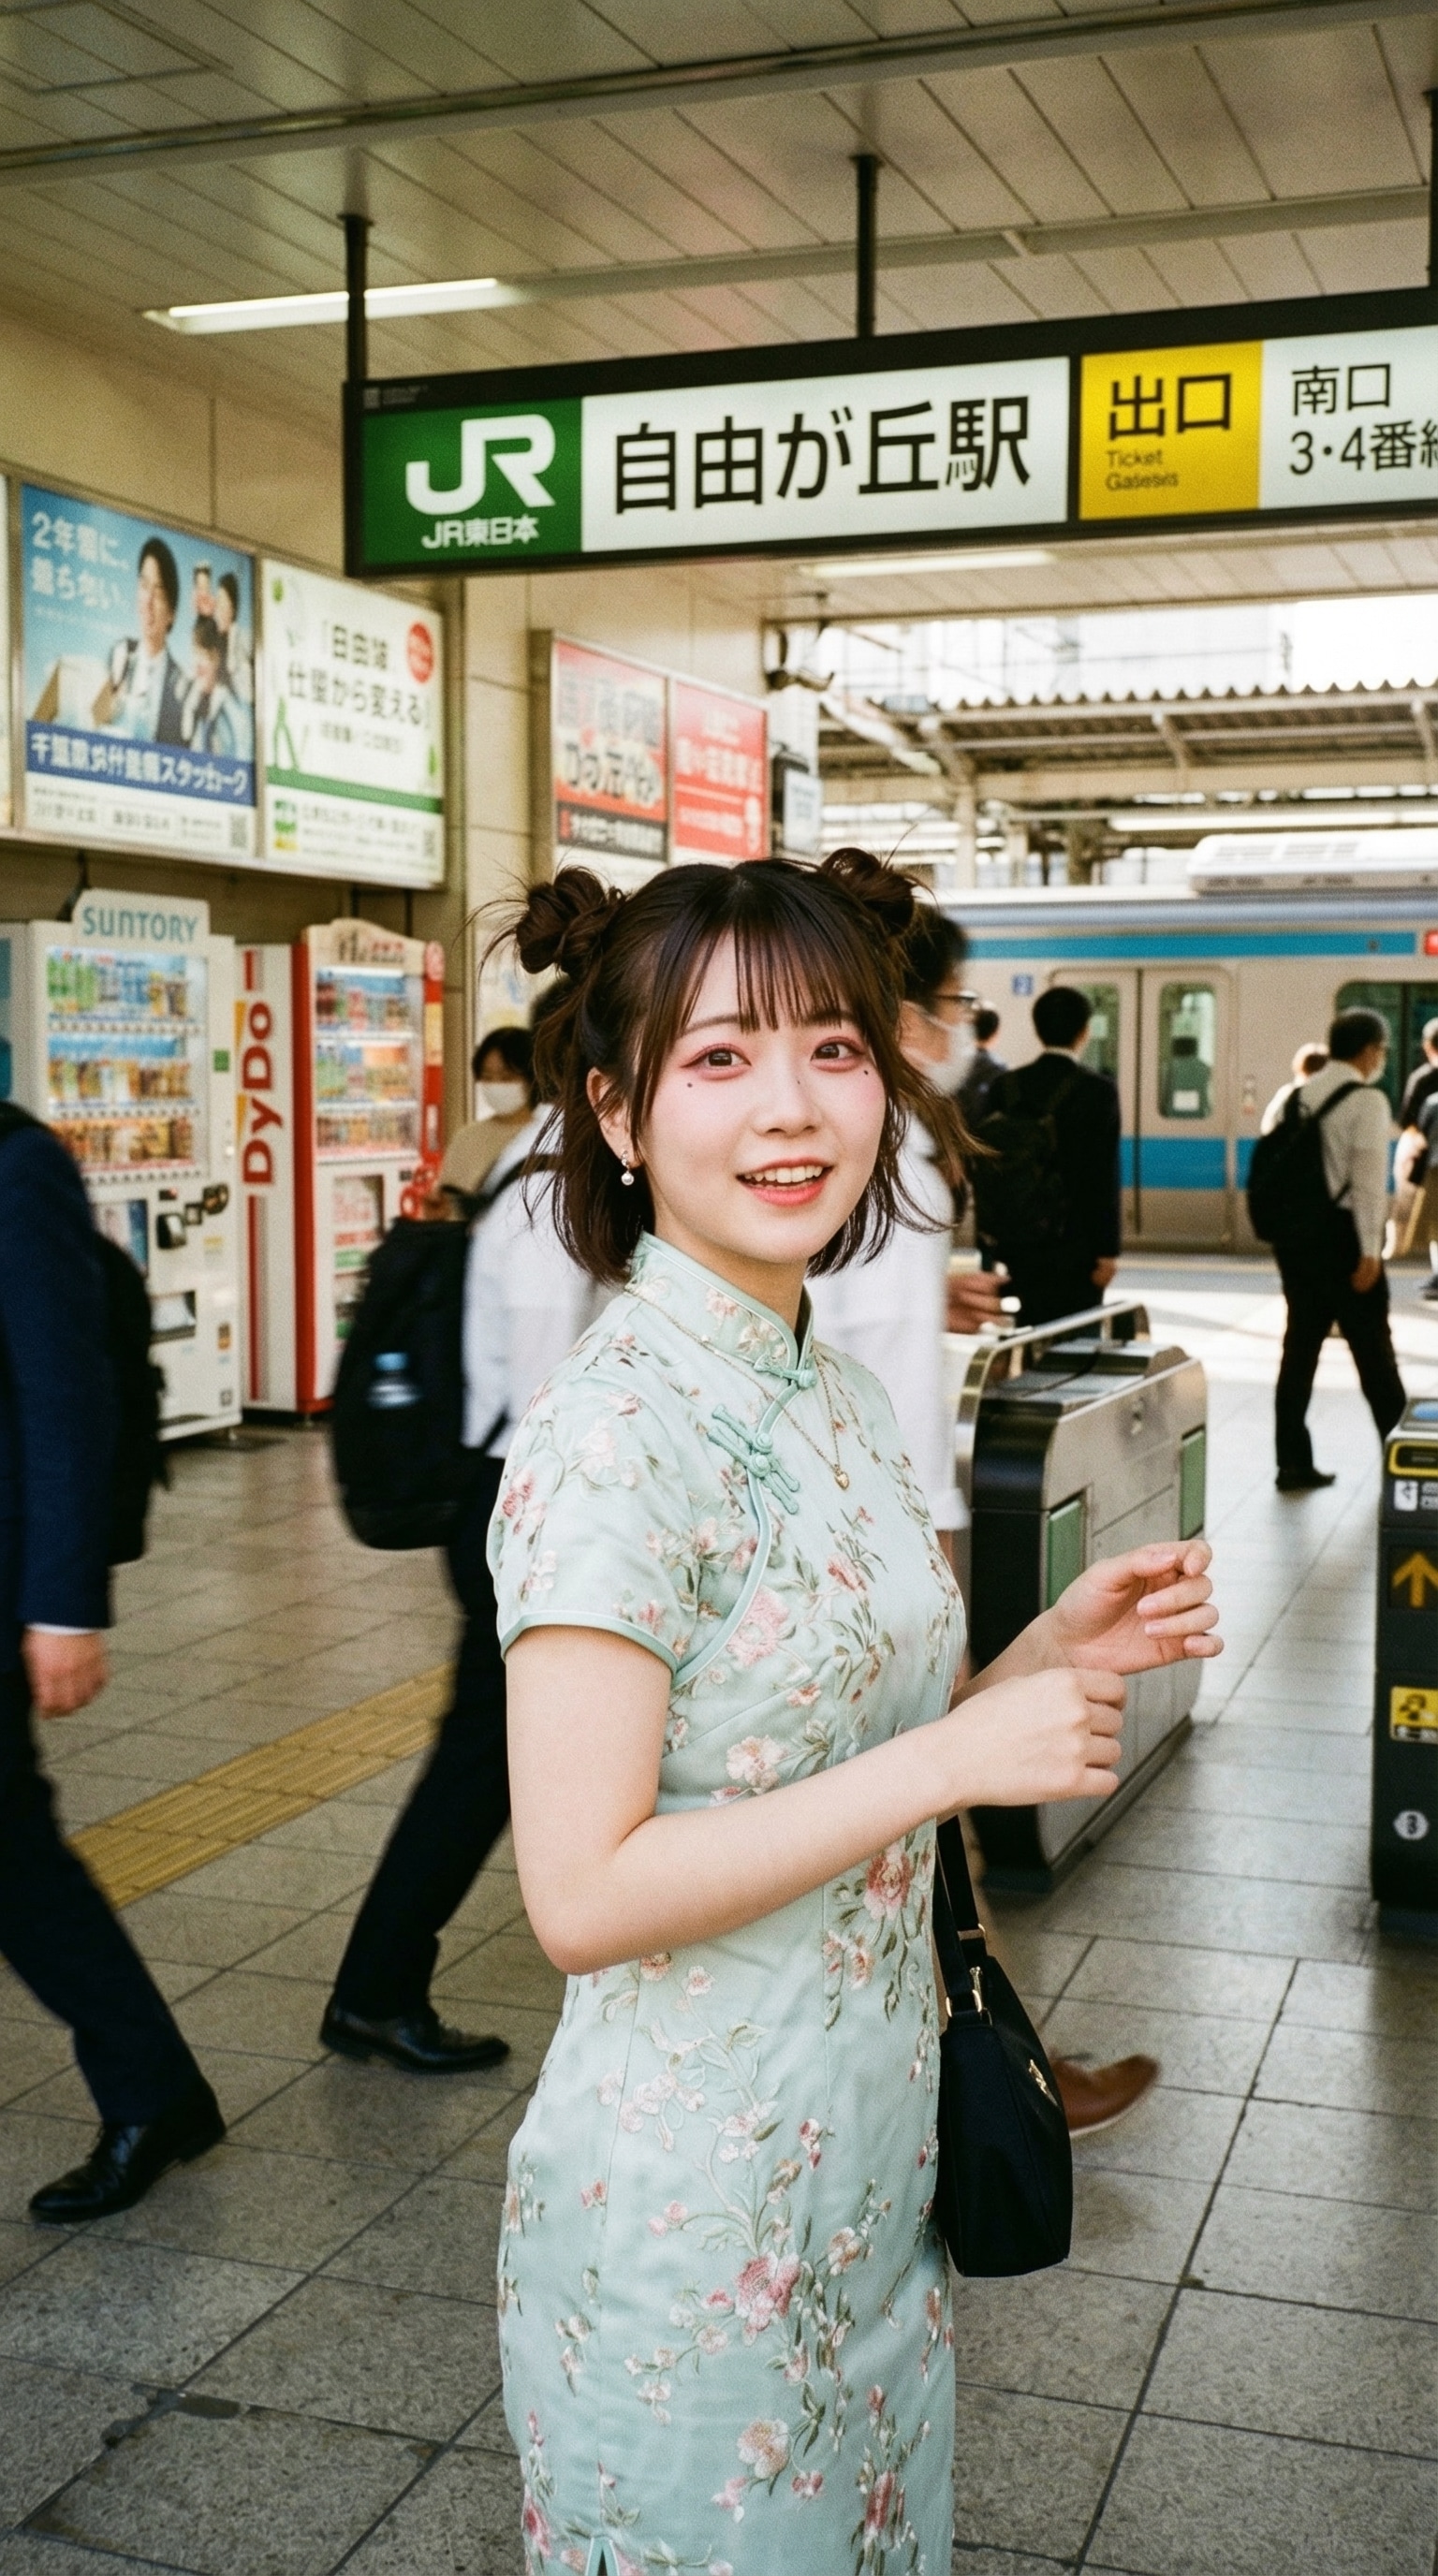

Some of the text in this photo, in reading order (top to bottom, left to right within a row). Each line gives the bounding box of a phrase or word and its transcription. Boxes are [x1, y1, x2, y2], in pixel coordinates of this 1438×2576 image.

[1108, 373, 1232, 441] 出口
[1291, 362, 1391, 417] 南口
[405, 414, 556, 515] JR
[616, 395, 1031, 514] 自由が丘駅
[1107, 448, 1163, 467] Ticket
[421, 514, 540, 549] JR東日本
[82, 906, 198, 944] SUNTORY
[242, 1002, 284, 1185] DyDo
